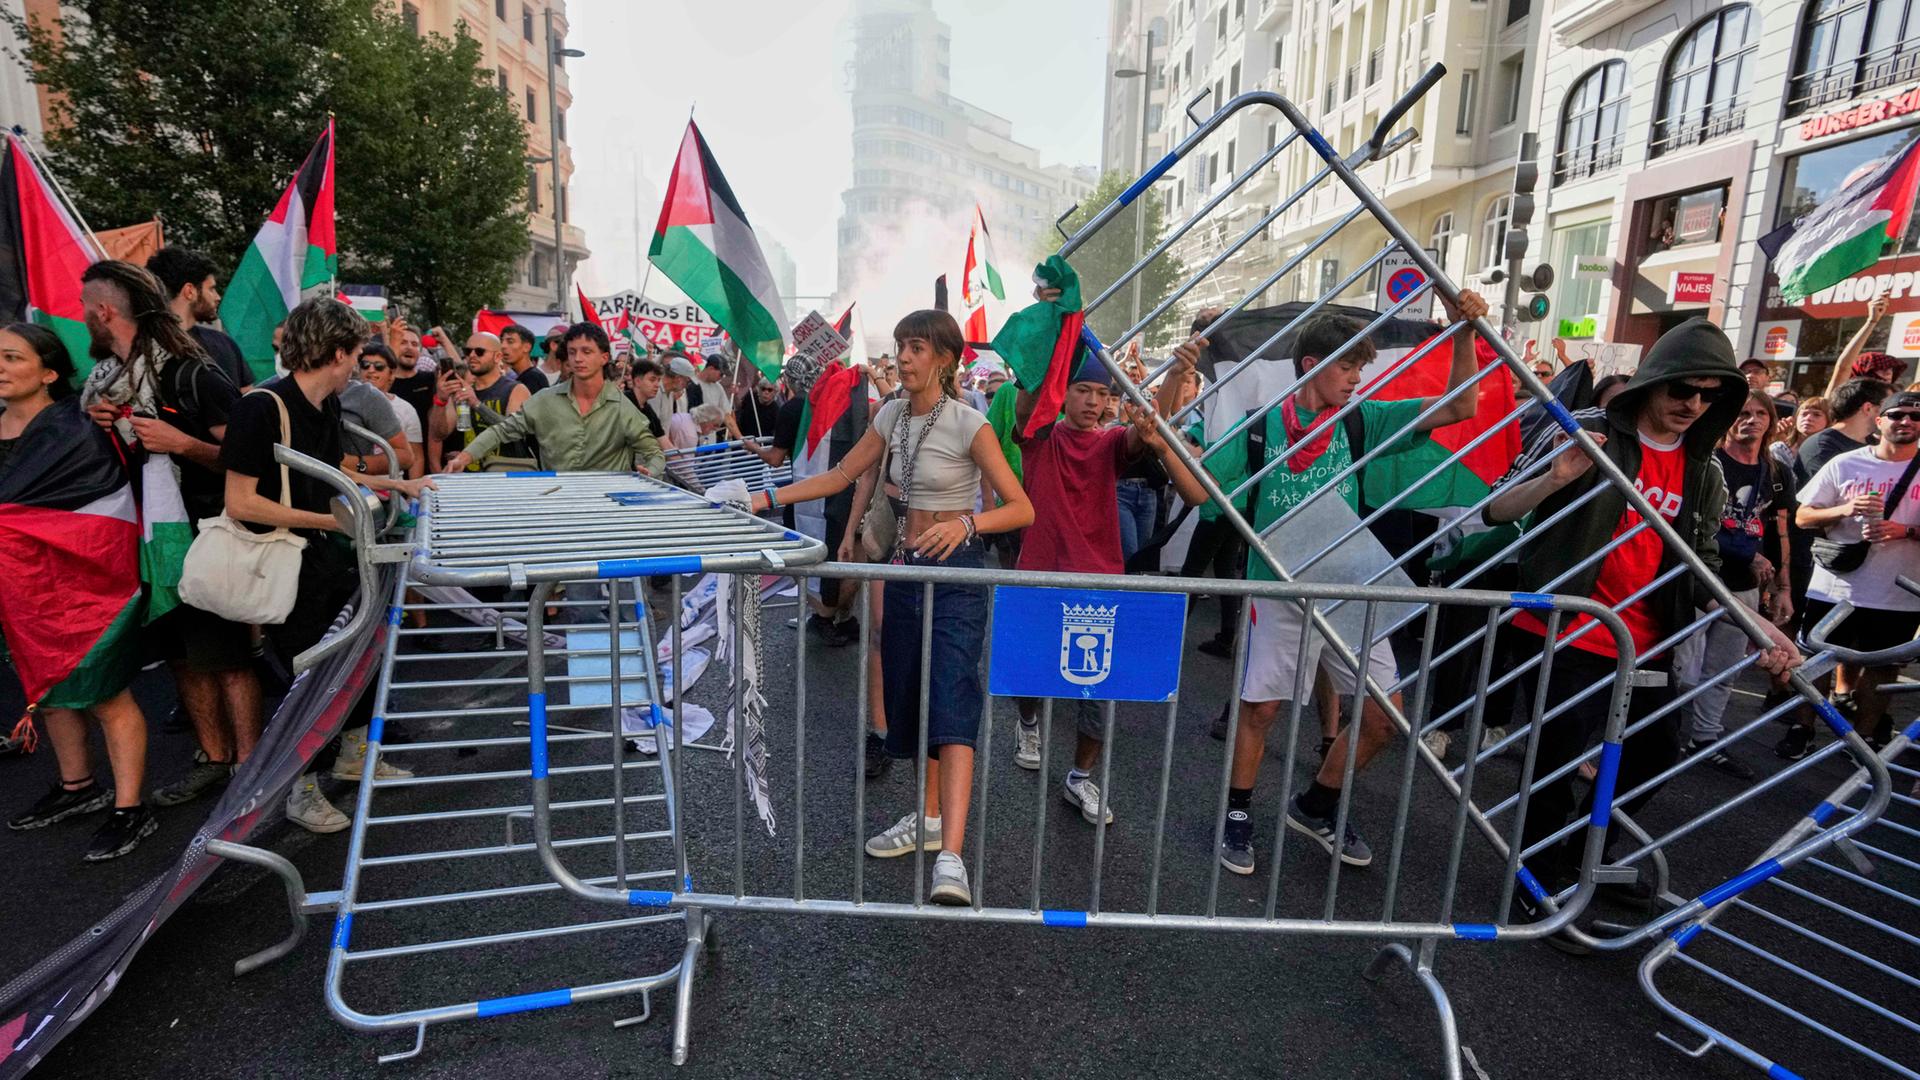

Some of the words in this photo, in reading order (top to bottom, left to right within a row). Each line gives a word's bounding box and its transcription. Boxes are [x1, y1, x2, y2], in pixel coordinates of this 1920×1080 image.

[1801, 100, 1887, 141] BURGER
[1888, 86, 1920, 115] KI
[1385, 258, 1397, 266] EN
[1402, 258, 1418, 266] AC
[1677, 283, 1712, 294] VIAJES
[592, 294, 680, 320] AREMOS
[686, 306, 703, 323] EL
[1766, 297, 1781, 309] OF
[793, 315, 825, 346] ISRAEL
[821, 331, 836, 344] LA
[816, 340, 848, 368] VUELTA
[1581, 343, 1627, 365] STOP
